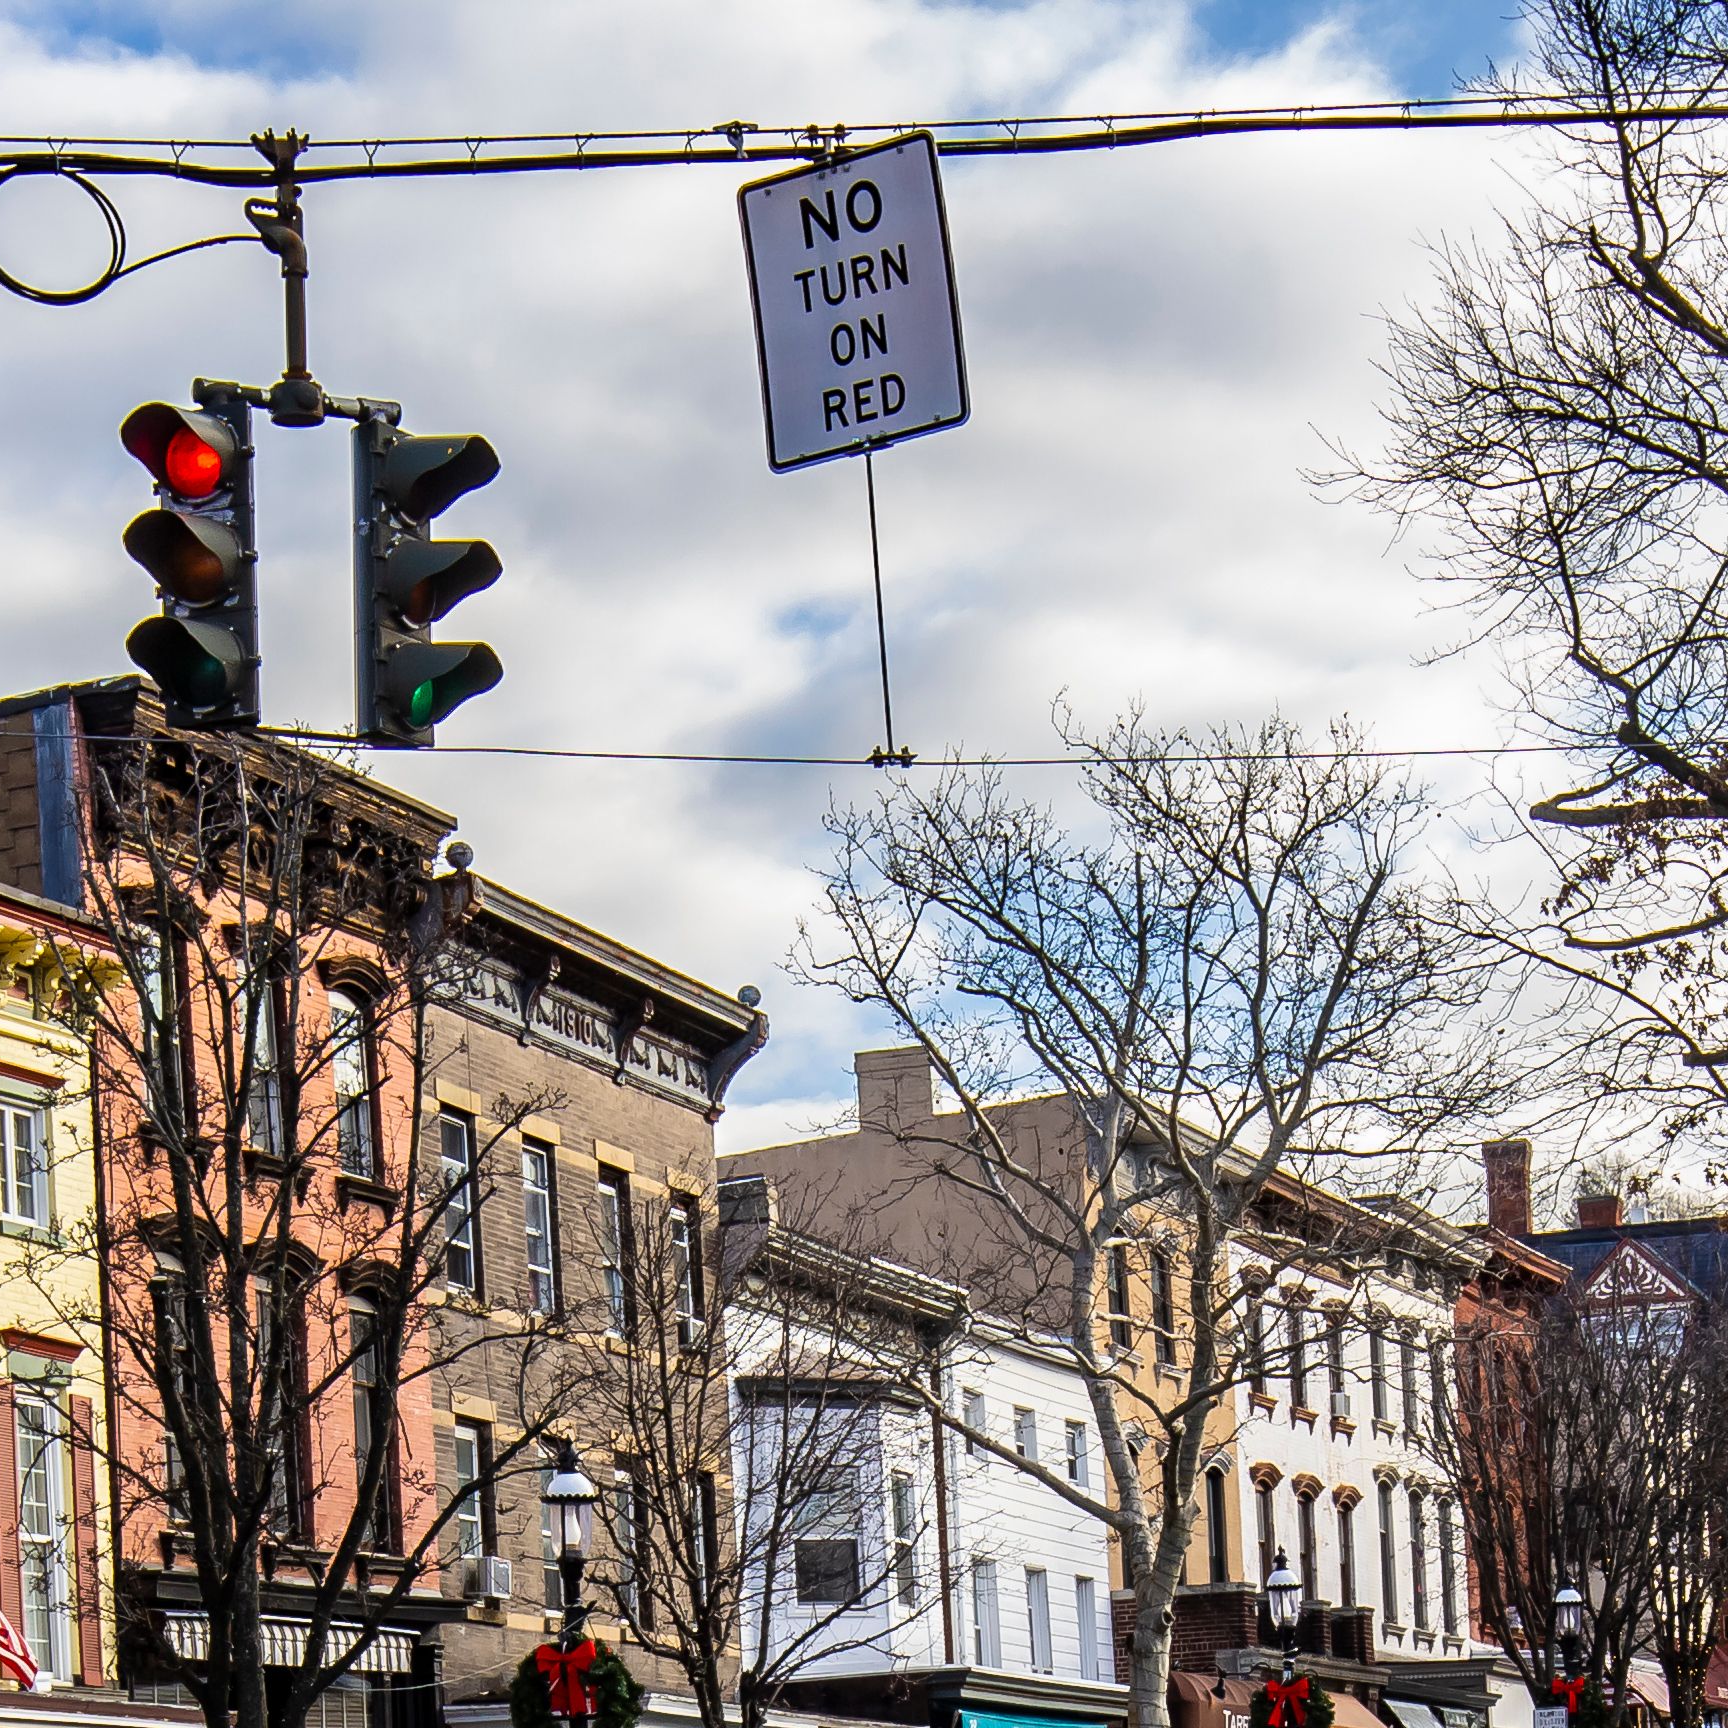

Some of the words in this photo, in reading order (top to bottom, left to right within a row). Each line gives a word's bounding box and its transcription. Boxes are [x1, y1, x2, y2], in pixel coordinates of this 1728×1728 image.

[798, 179, 882, 249] NO
[793, 243, 910, 313] TURN
[830, 313, 888, 367] ON
[822, 373, 906, 432] RED
